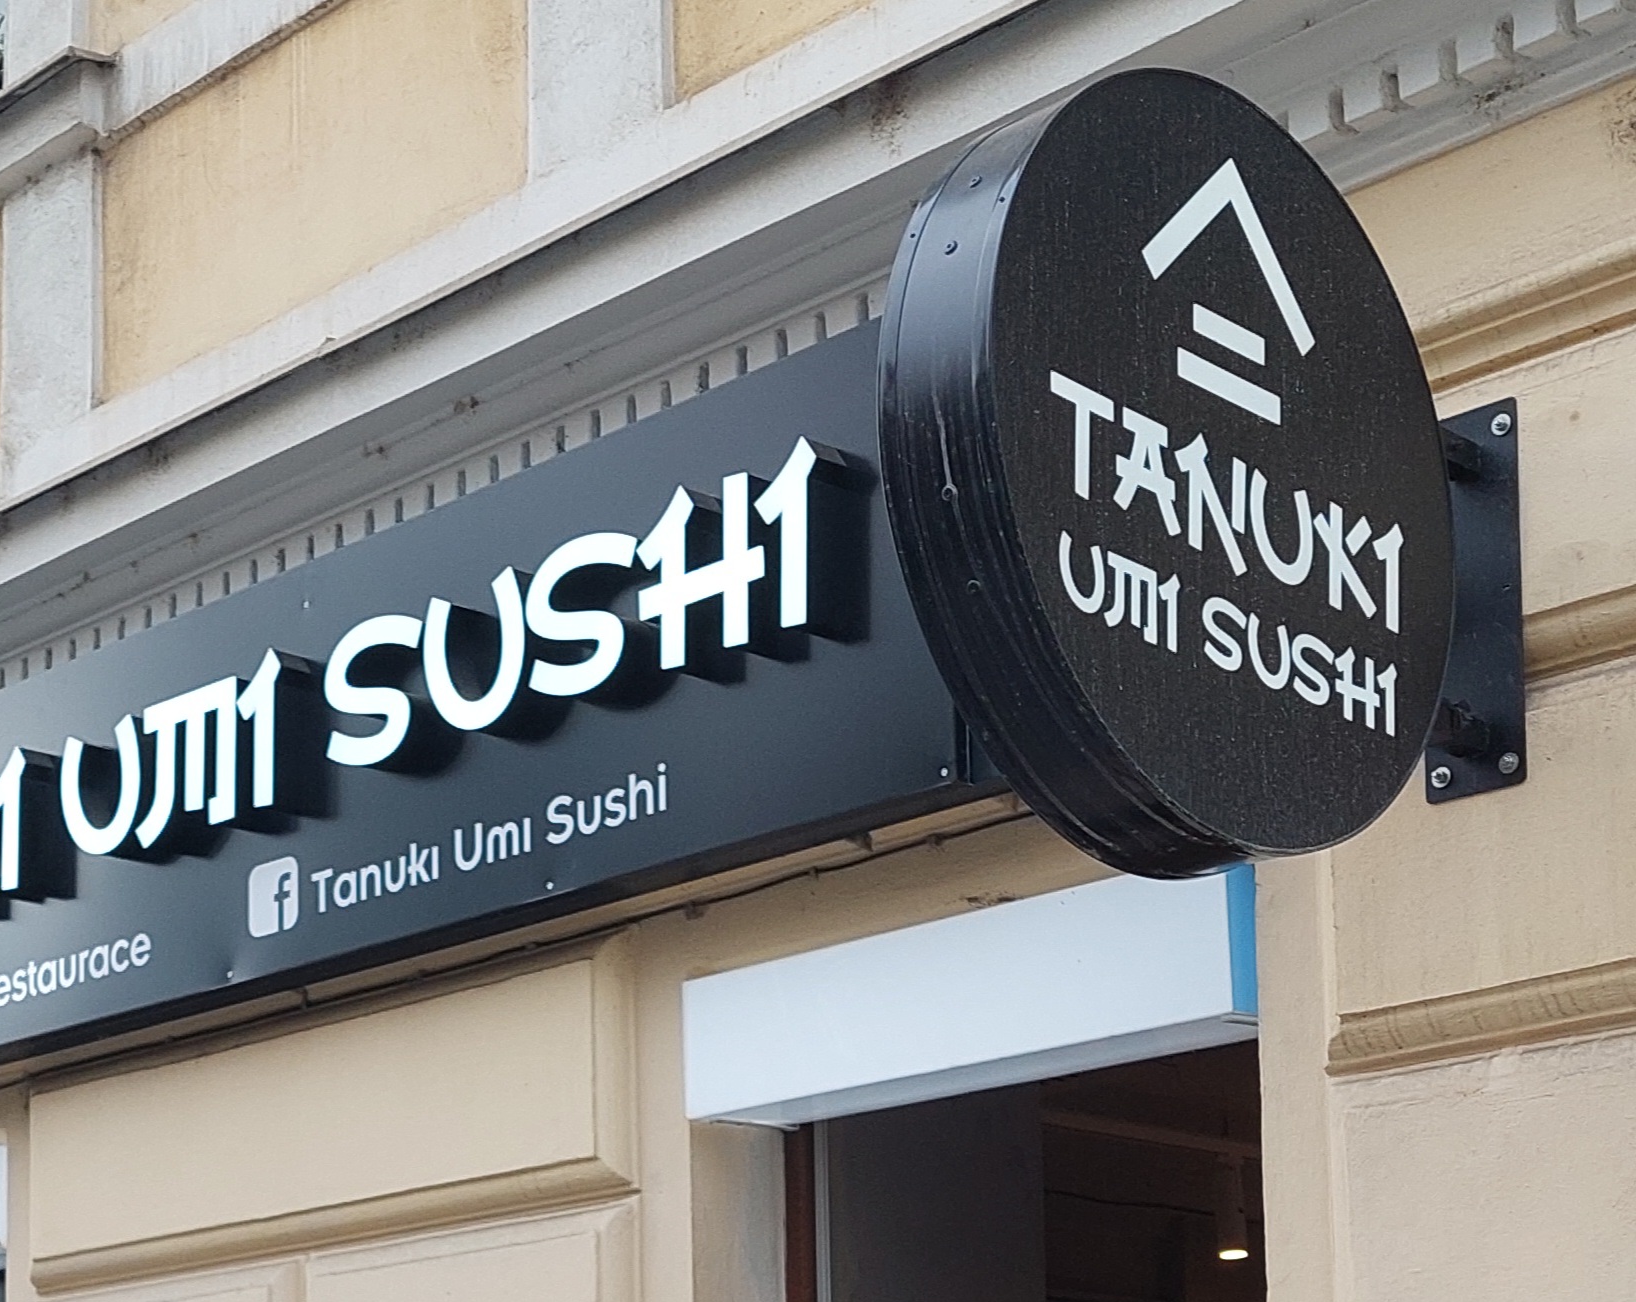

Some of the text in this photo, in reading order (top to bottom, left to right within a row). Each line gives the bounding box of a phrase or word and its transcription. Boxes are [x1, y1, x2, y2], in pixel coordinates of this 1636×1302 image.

[1049, 369, 1405, 635] TANUKI
[60, 646, 282, 857] UMI
[324, 435, 818, 768] SUSHI
[1058, 530, 1399, 738] UMI SUSHI
[310, 762, 668, 913] Tanuki Umi Sushi
